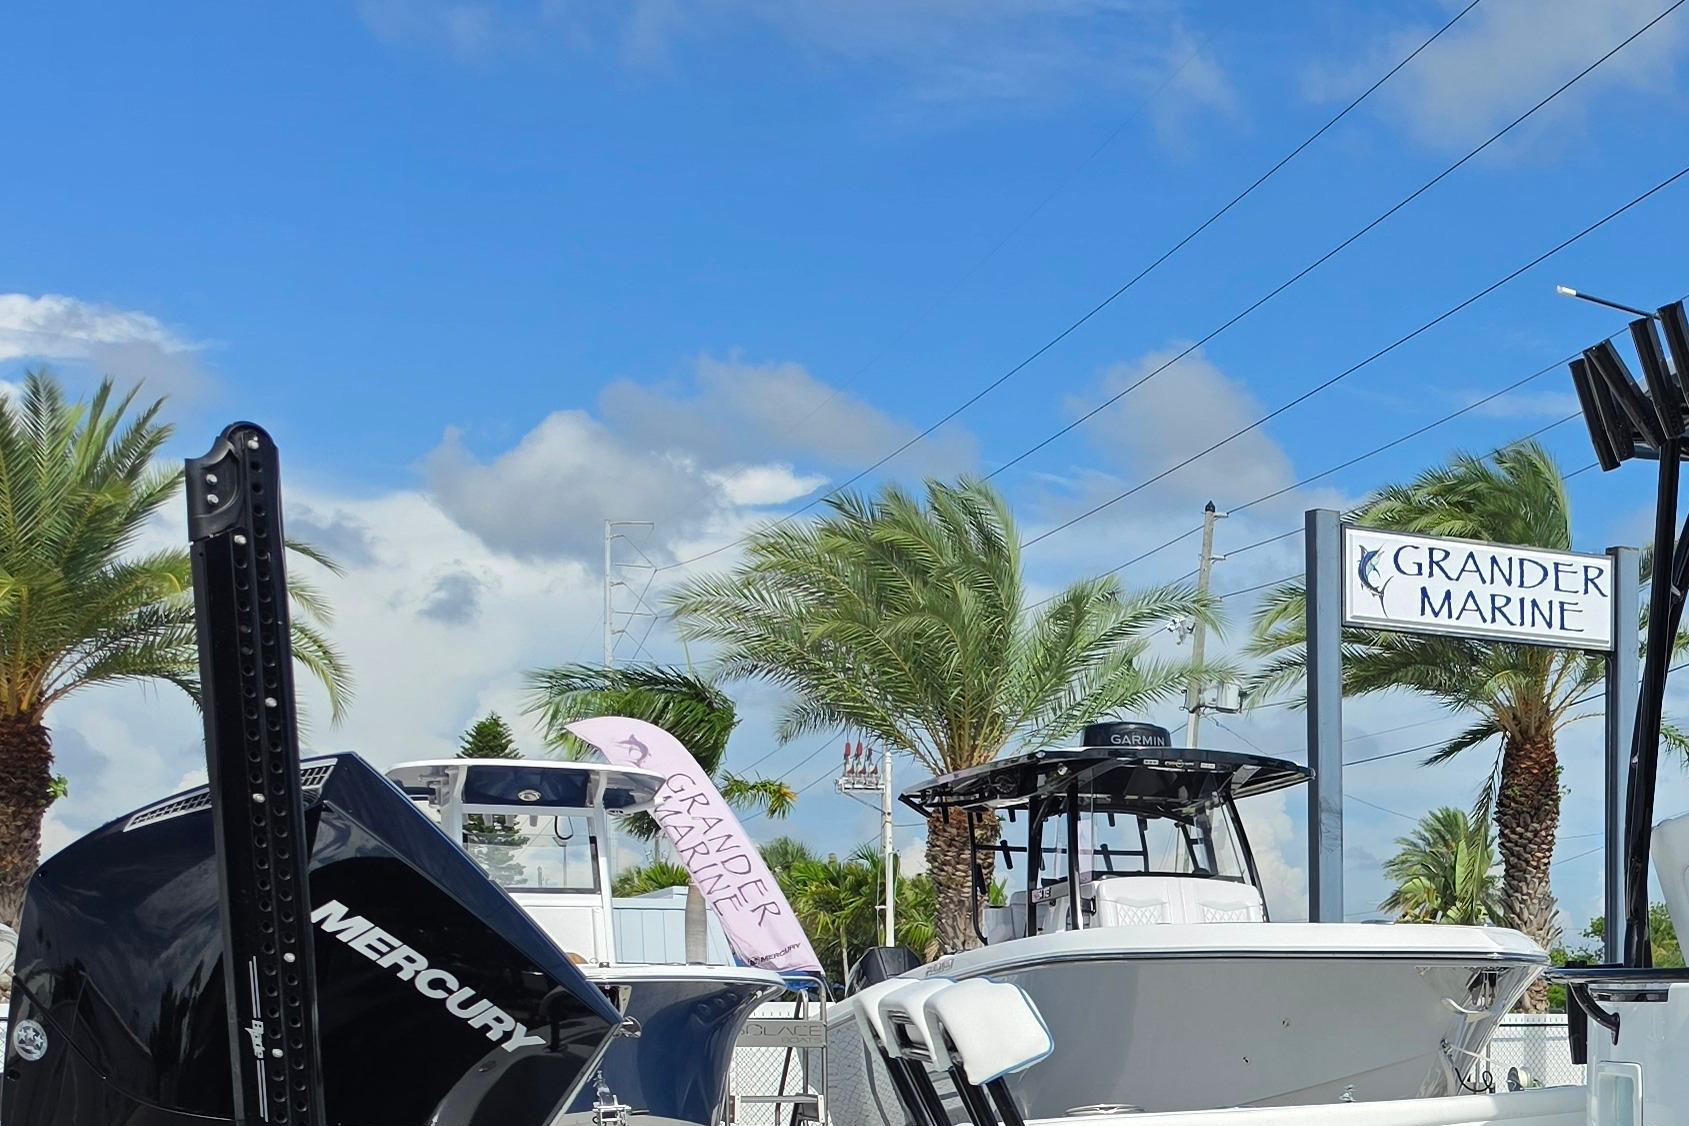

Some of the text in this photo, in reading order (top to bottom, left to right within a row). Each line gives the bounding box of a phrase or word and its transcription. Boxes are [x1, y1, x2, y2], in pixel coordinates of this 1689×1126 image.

[1393, 545, 1608, 598] GRANDER
[1420, 586, 1584, 632] MARINE
[1110, 734, 1165, 746] GARMIN
[654, 797, 742, 917] MARINE
[665, 773, 781, 927] GRANDER
[310, 899, 547, 1053] MERCURY
[760, 942, 801, 963] MERCURY
